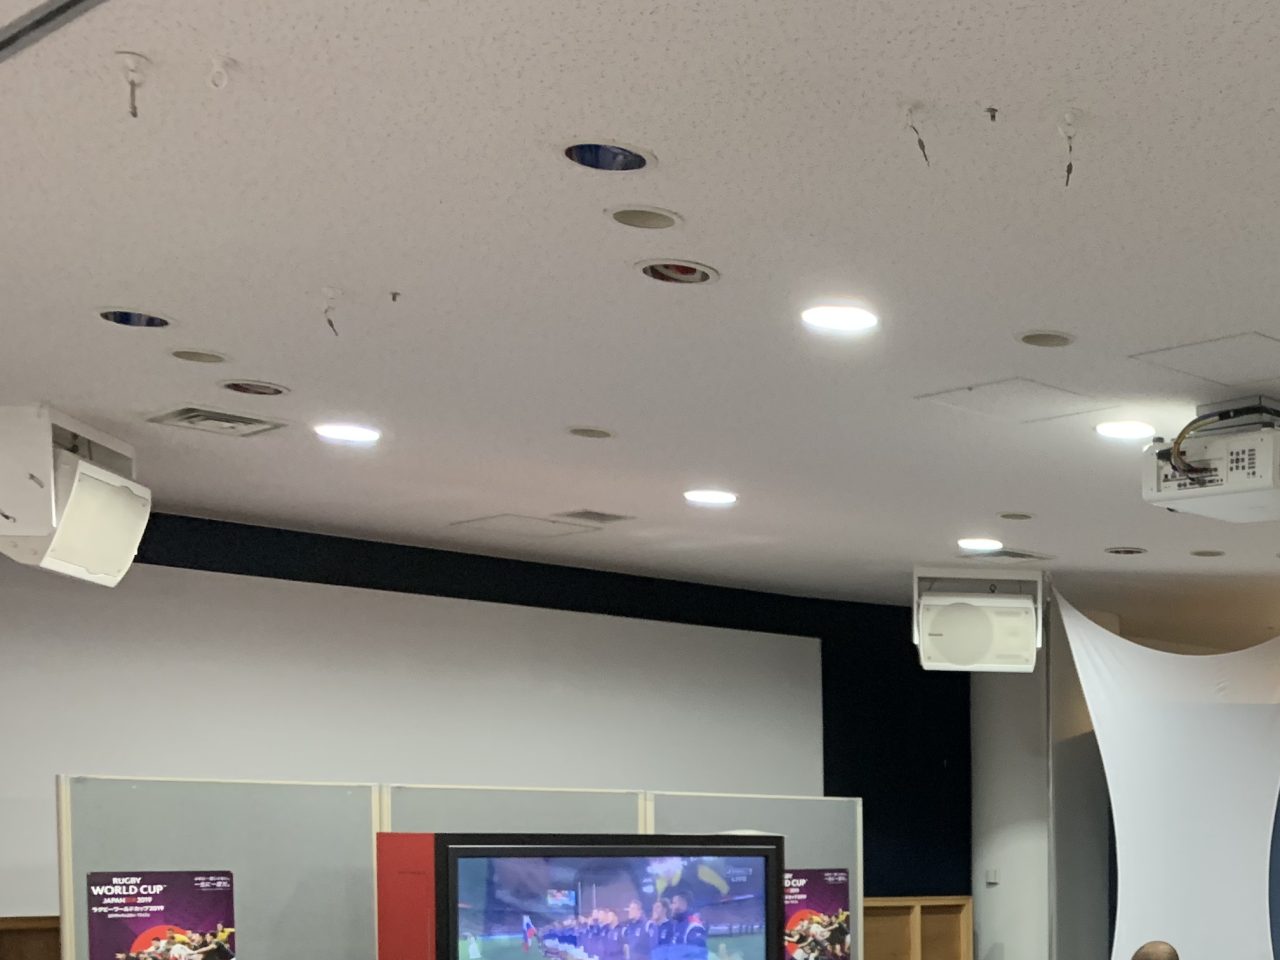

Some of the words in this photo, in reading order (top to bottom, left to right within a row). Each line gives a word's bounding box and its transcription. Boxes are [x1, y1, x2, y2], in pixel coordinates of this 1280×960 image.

[112, 877, 142, 885] RUGBY
[791, 879, 807, 887] CUP
[91, 885, 138, 896] WORLD
[140, 884, 164, 895] CUP
